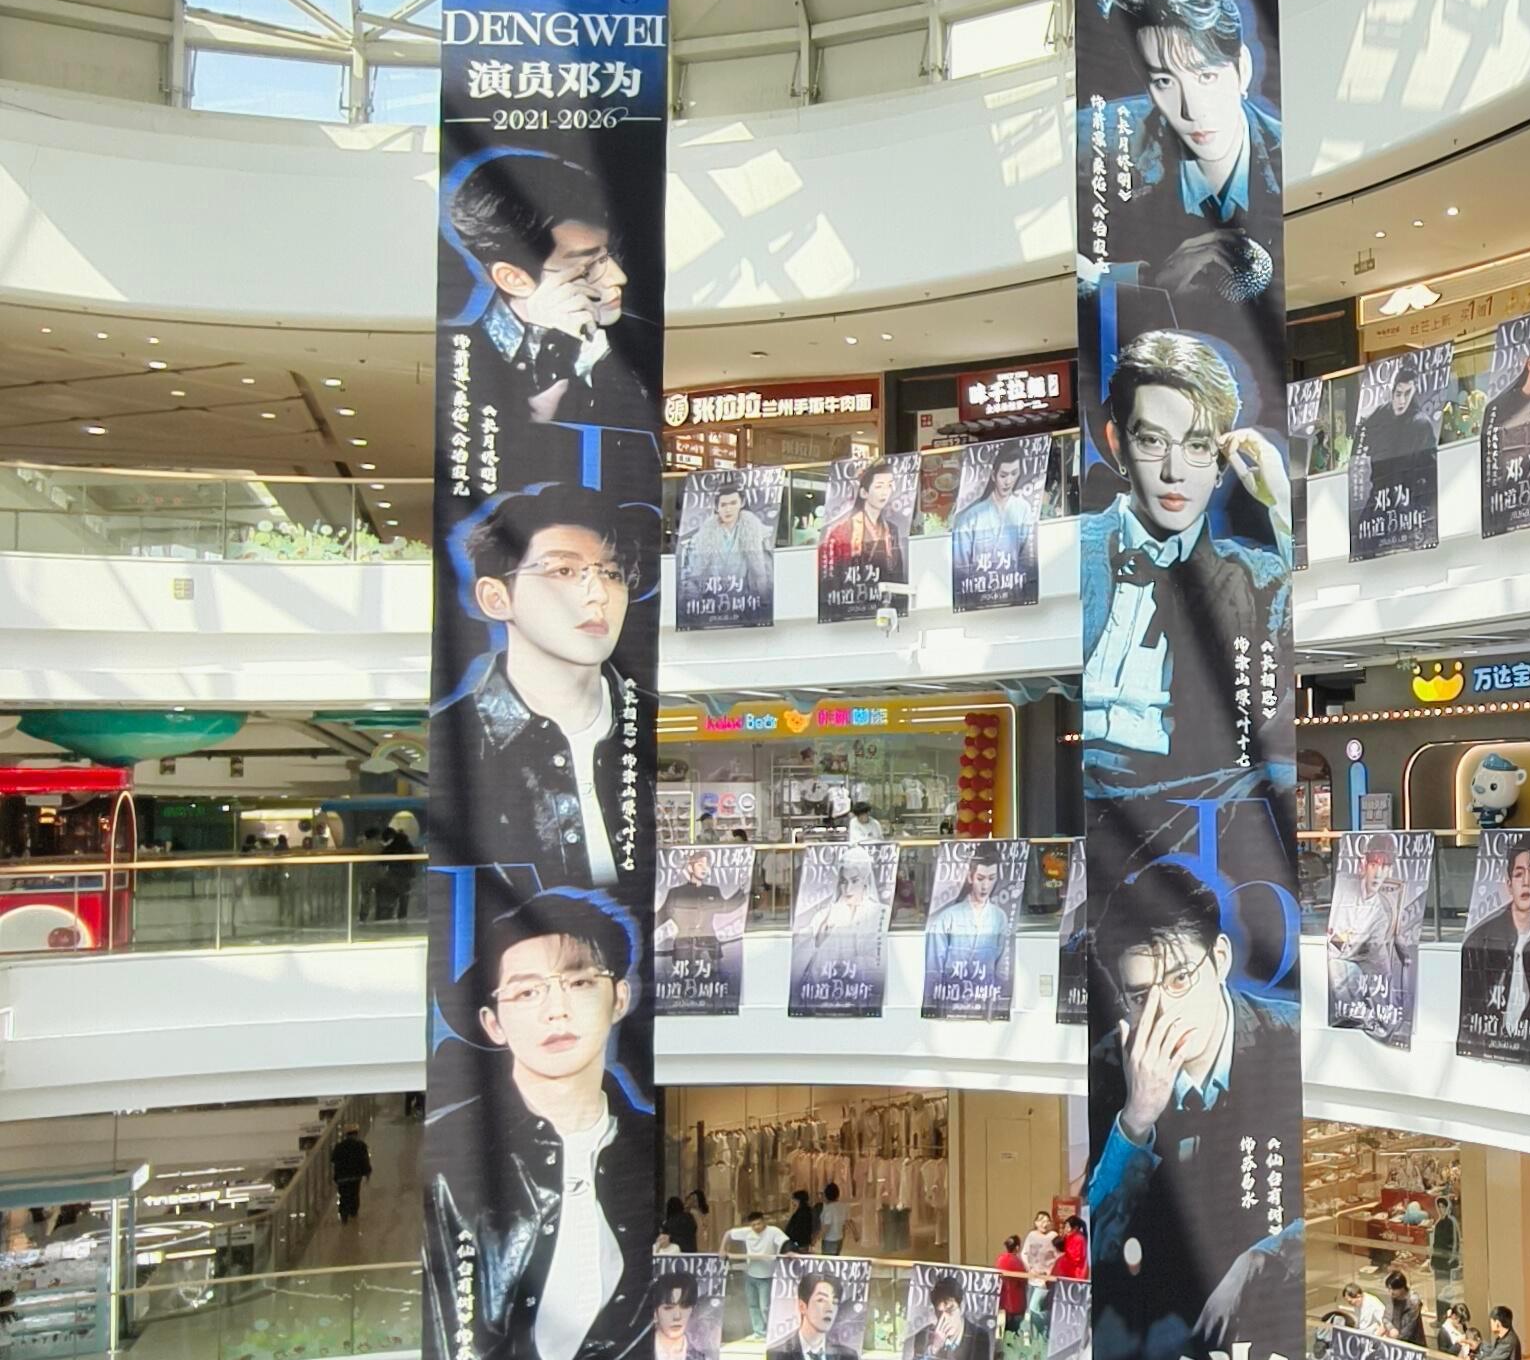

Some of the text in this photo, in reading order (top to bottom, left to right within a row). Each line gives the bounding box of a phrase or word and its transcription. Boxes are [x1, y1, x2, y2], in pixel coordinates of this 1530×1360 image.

[442, 10, 666, 47] DENGWEI
[468, 59, 642, 98] 演员邓为
[493, 107, 628, 131] 2021-2026
[1374, 484, 1410, 512] 邓为
[977, 551, 1011, 572] 邓为
[844, 566, 880, 586] 邓为
[672, 959, 712, 978] 邓为
